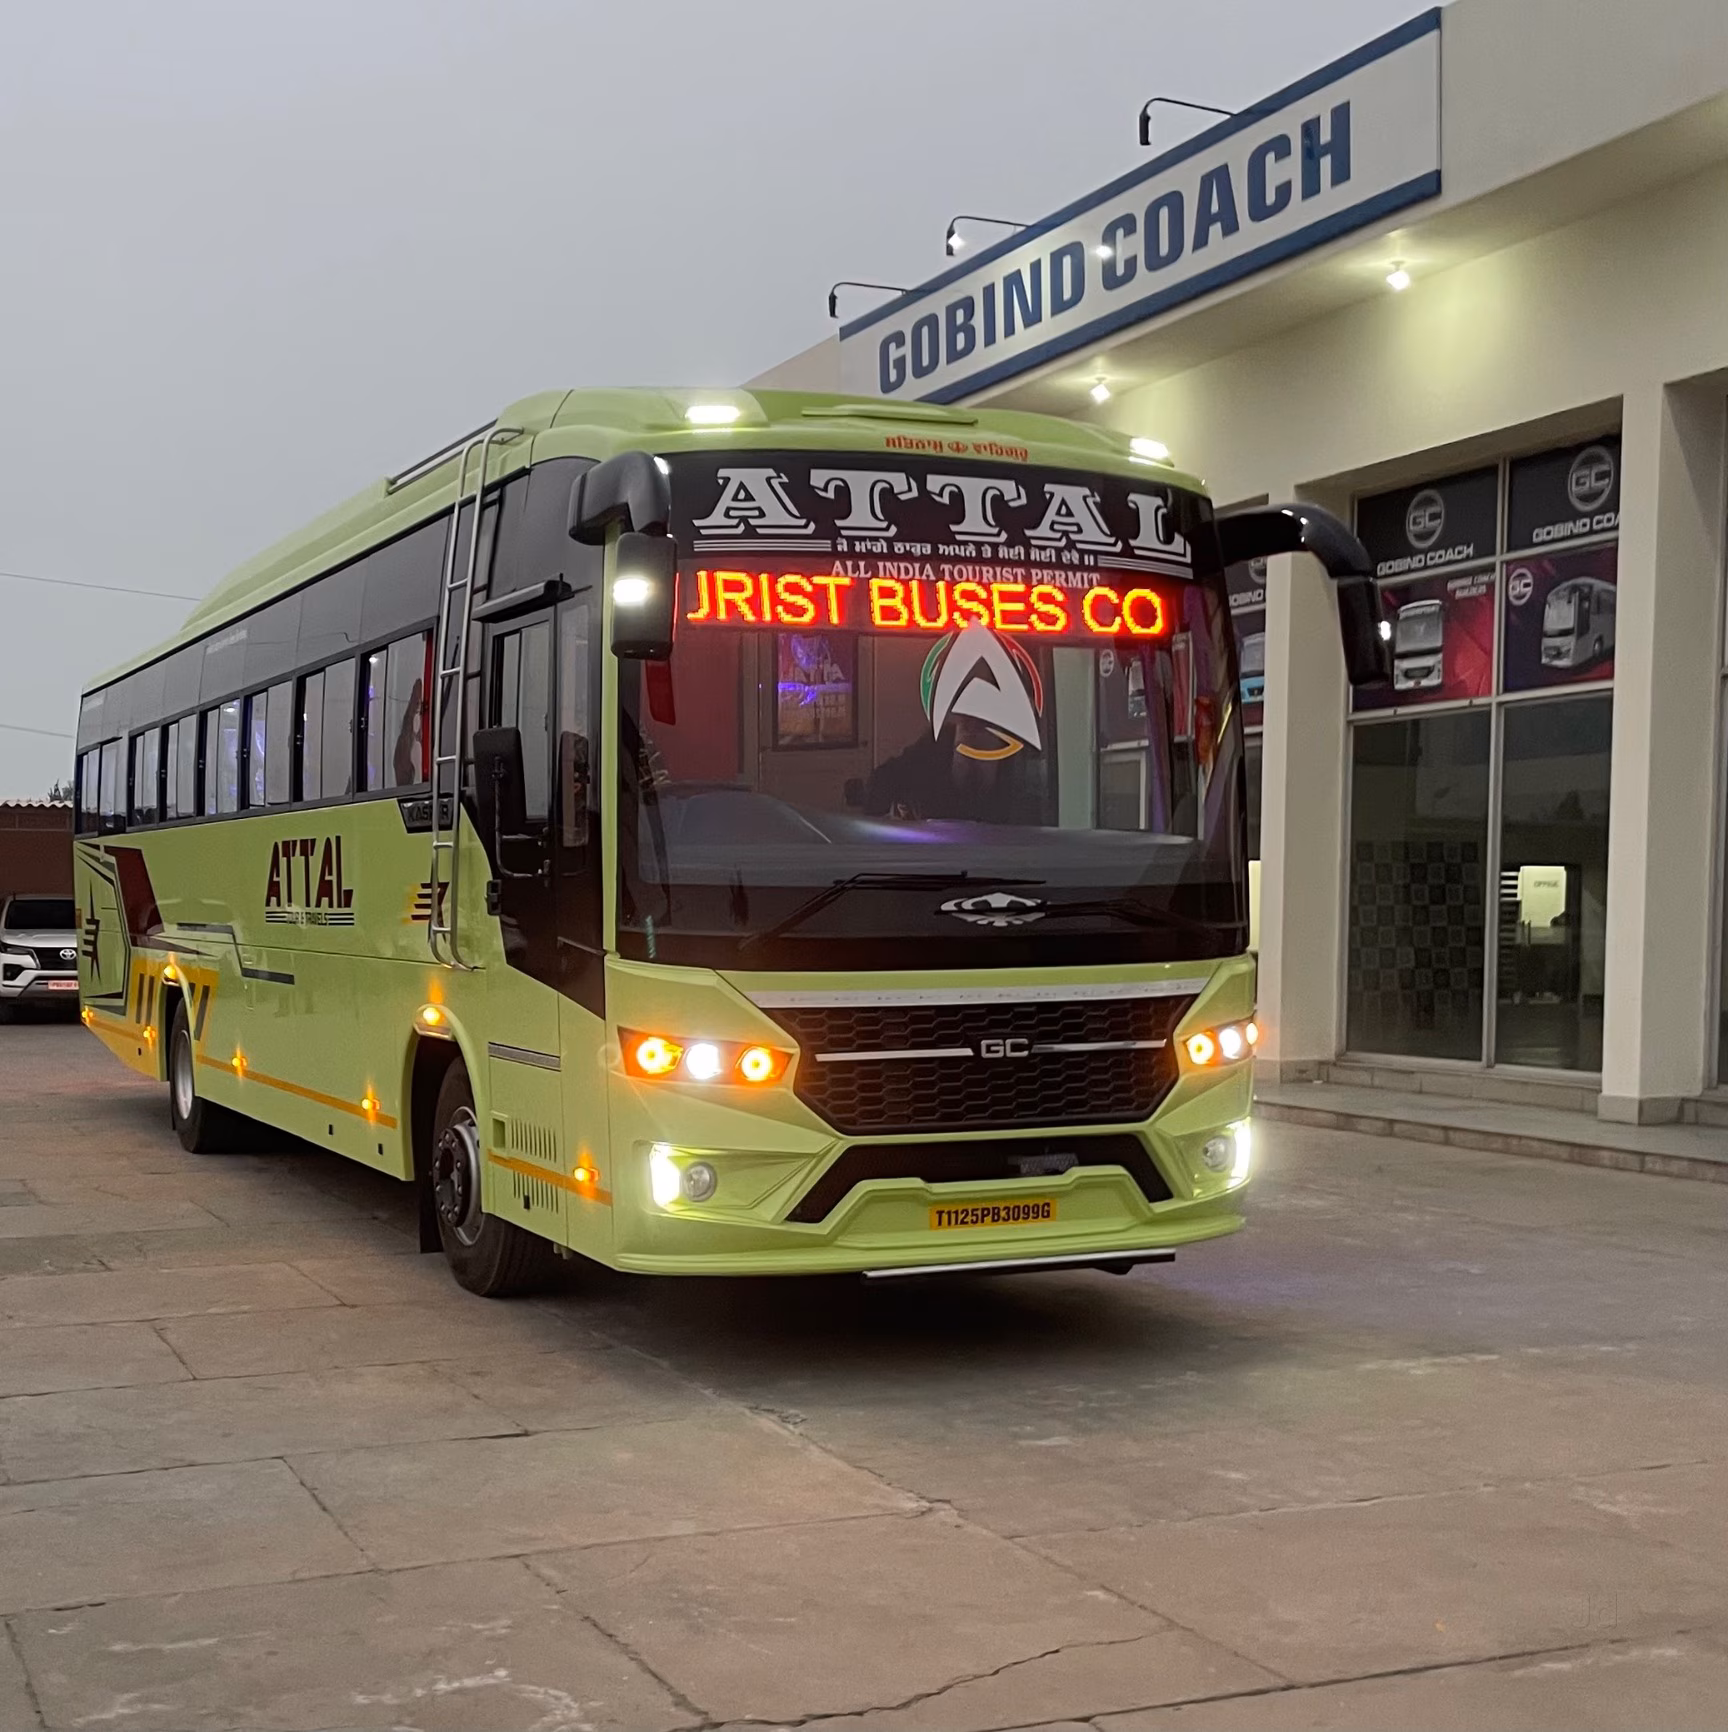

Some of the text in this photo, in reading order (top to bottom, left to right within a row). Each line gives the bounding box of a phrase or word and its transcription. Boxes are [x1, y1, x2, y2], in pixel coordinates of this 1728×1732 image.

[879, 100, 1352, 394] GOBIND COACH
[1572, 464, 1610, 492] GC
[693, 467, 1192, 563] ATTAL
[1409, 507, 1442, 530] GC
[1532, 517, 1590, 544] GOBIND
[1377, 543, 1474, 576] GOBIND COACH
[832, 560, 1100, 588] ALL INDIA TOURIST PERMIT
[869, 578, 1068, 632] BUSES
[1082, 586, 1163, 634] CO
[265, 835, 354, 909] ATTAL
[980, 1038, 1029, 1059] GC
[936, 1202, 1051, 1227] T1125PB3099G
